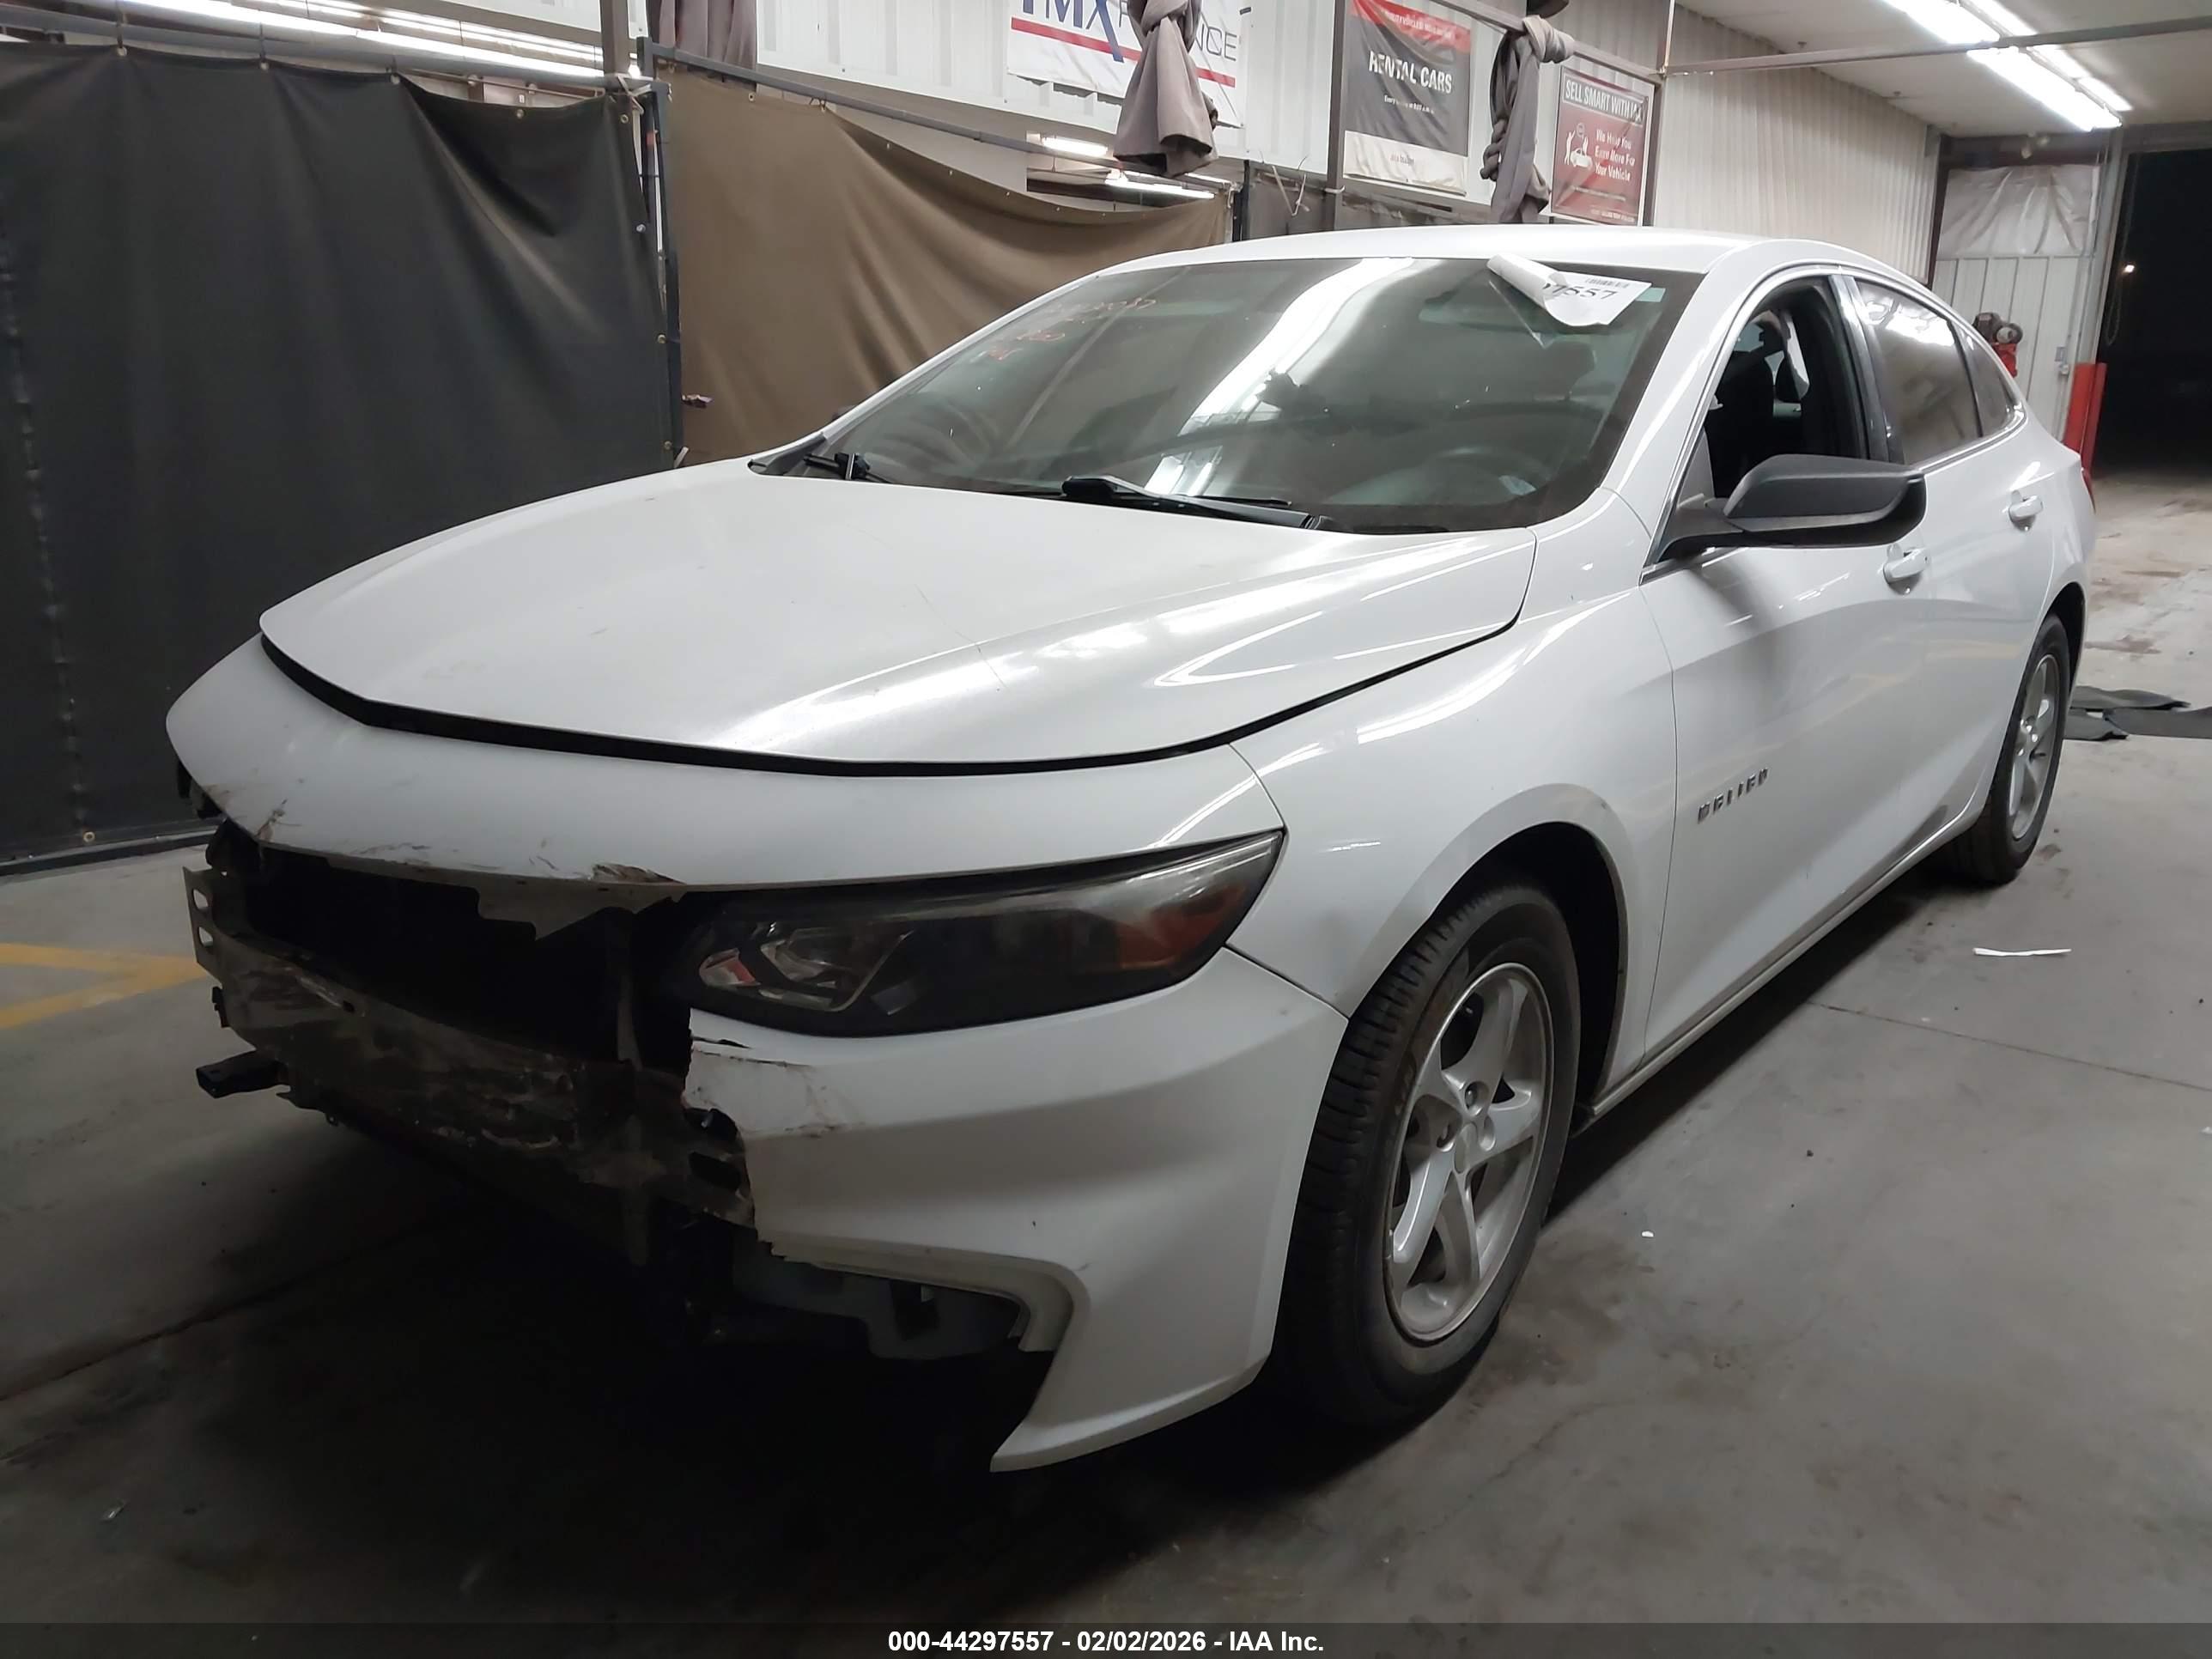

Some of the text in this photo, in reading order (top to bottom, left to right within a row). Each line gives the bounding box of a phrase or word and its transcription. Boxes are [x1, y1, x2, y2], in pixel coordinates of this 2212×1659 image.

[1369, 51, 1452, 94] RENTAL CARS
[1565, 79, 1583, 102] SELL
[1583, 86, 1610, 112] SMART
[1611, 95, 1630, 118] WITH
